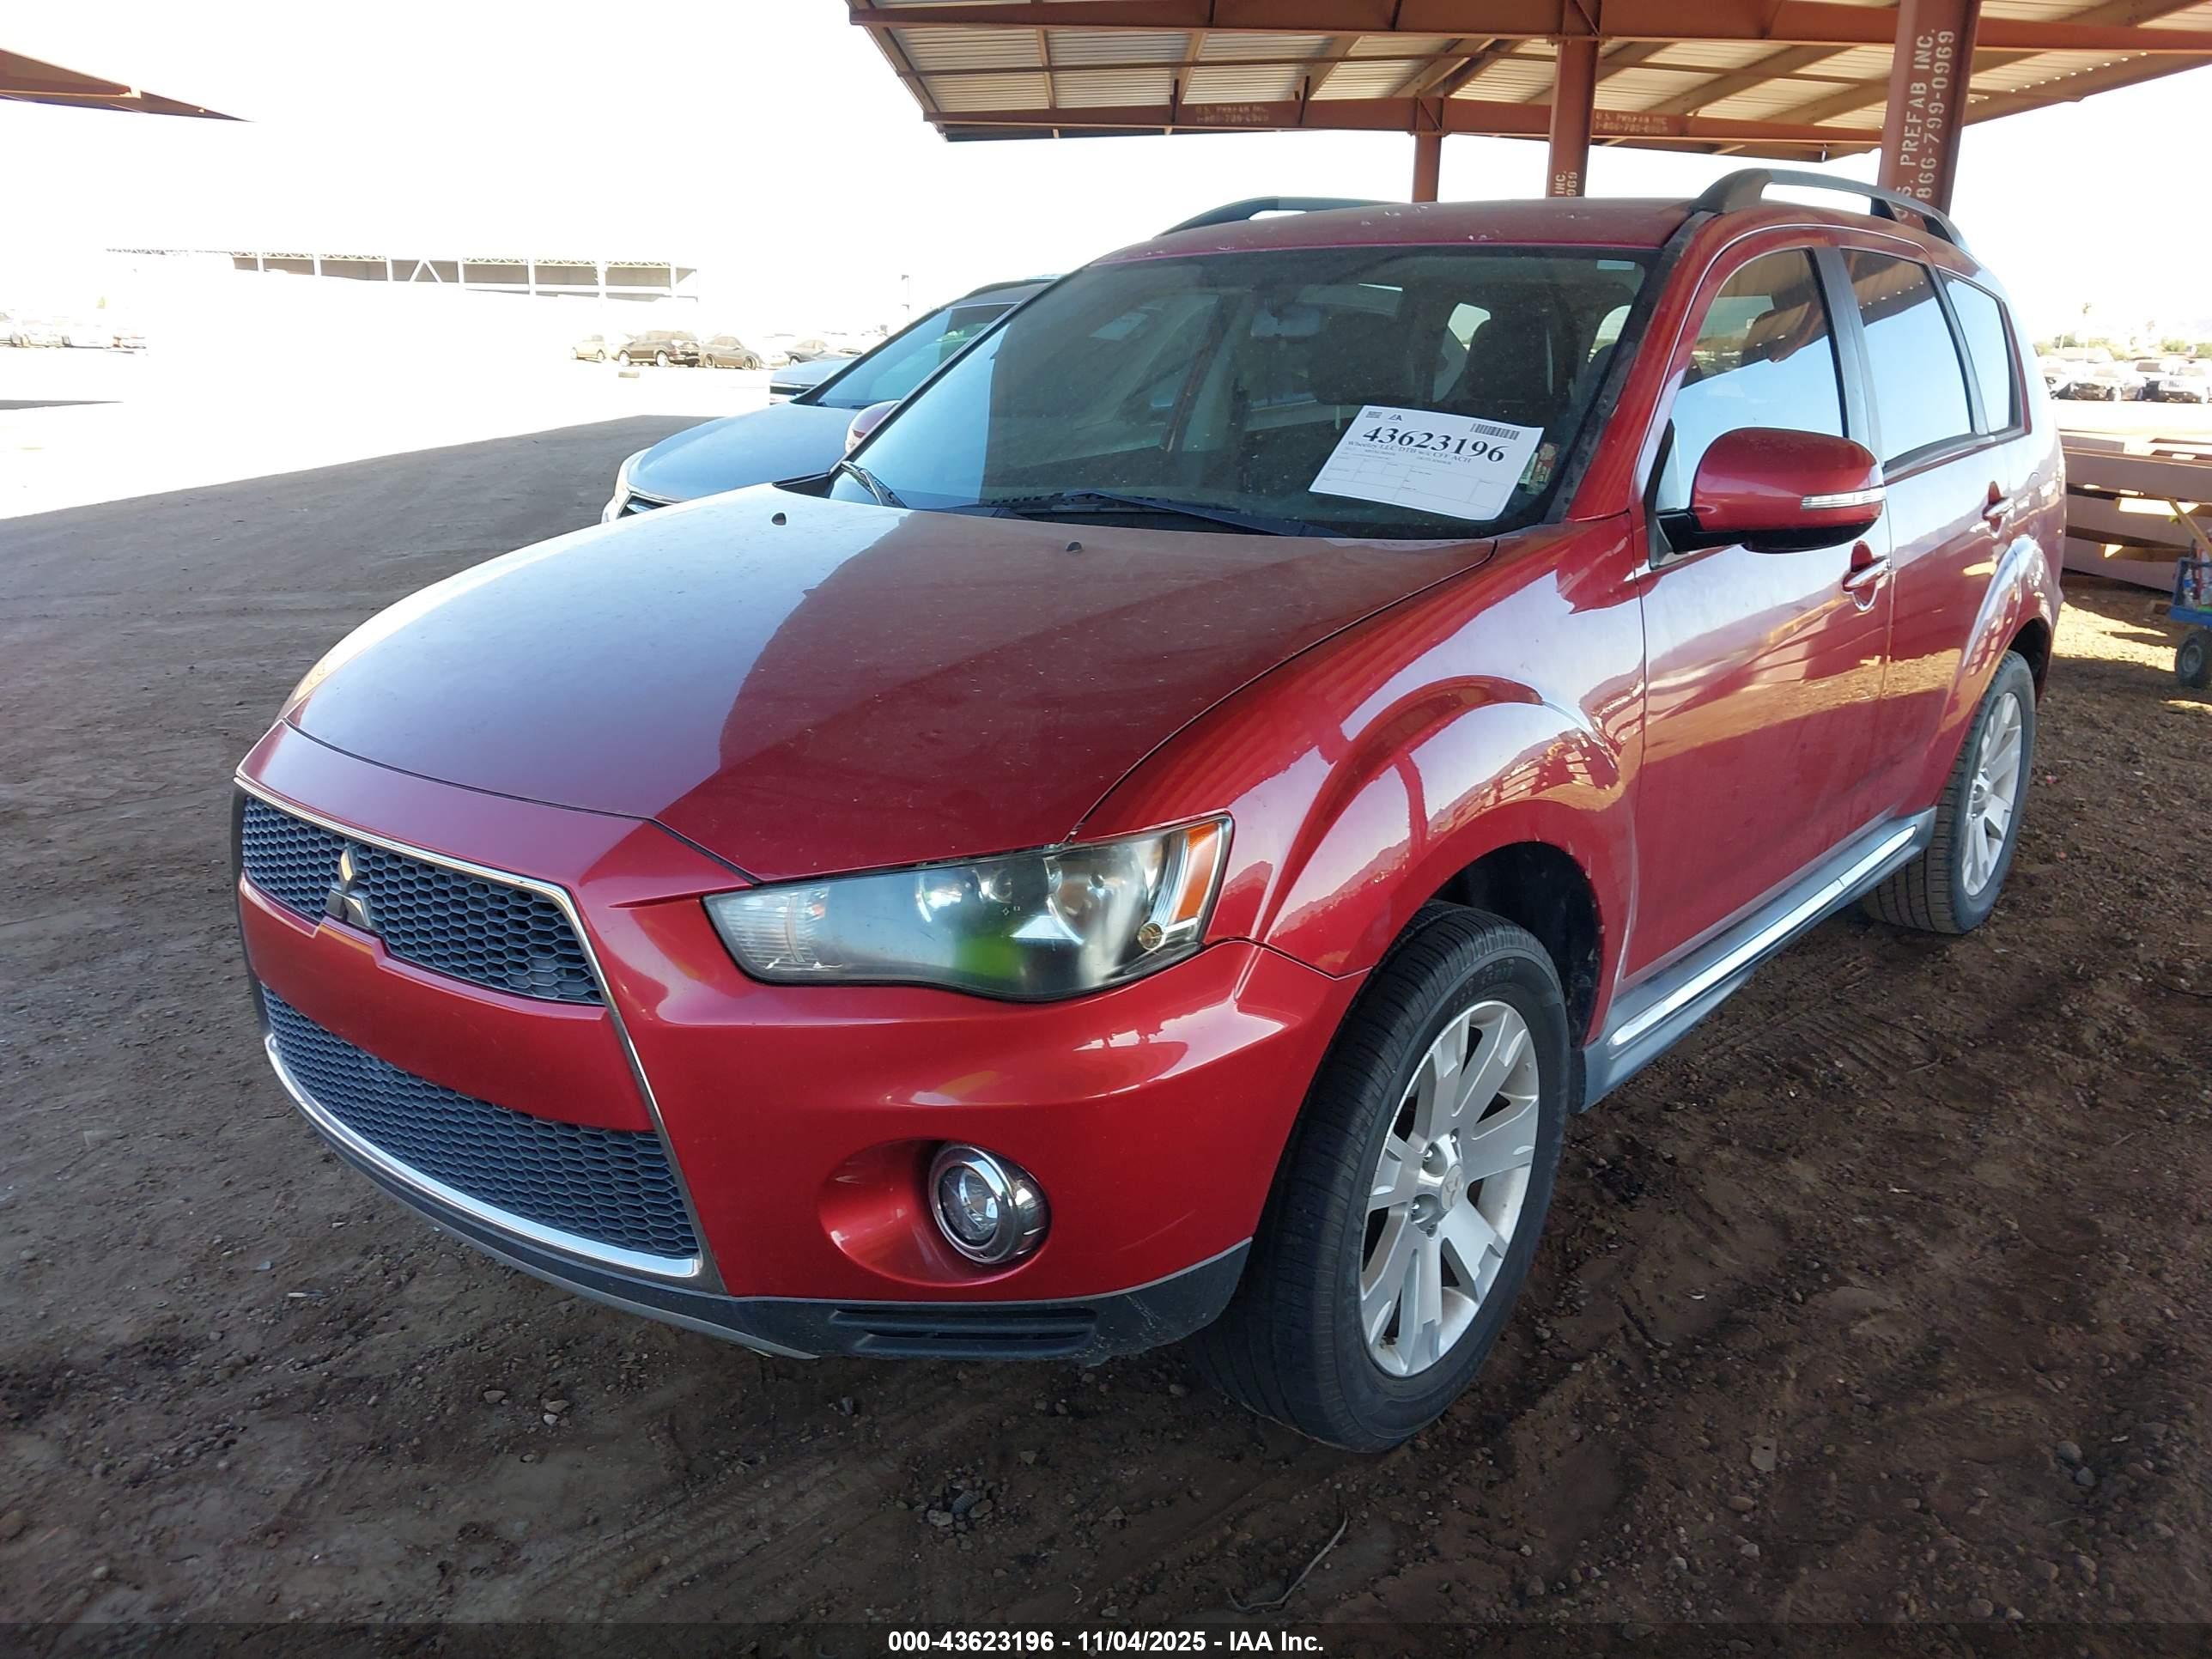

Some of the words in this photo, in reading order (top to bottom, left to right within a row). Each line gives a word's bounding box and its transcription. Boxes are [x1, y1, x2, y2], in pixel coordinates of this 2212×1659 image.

[1913, 28, 1936, 70] INC.
[1900, 82, 1927, 166] PREFAB
[1555, 171, 1567, 195] INC.
[1363, 426, 1510, 462] 43623196
